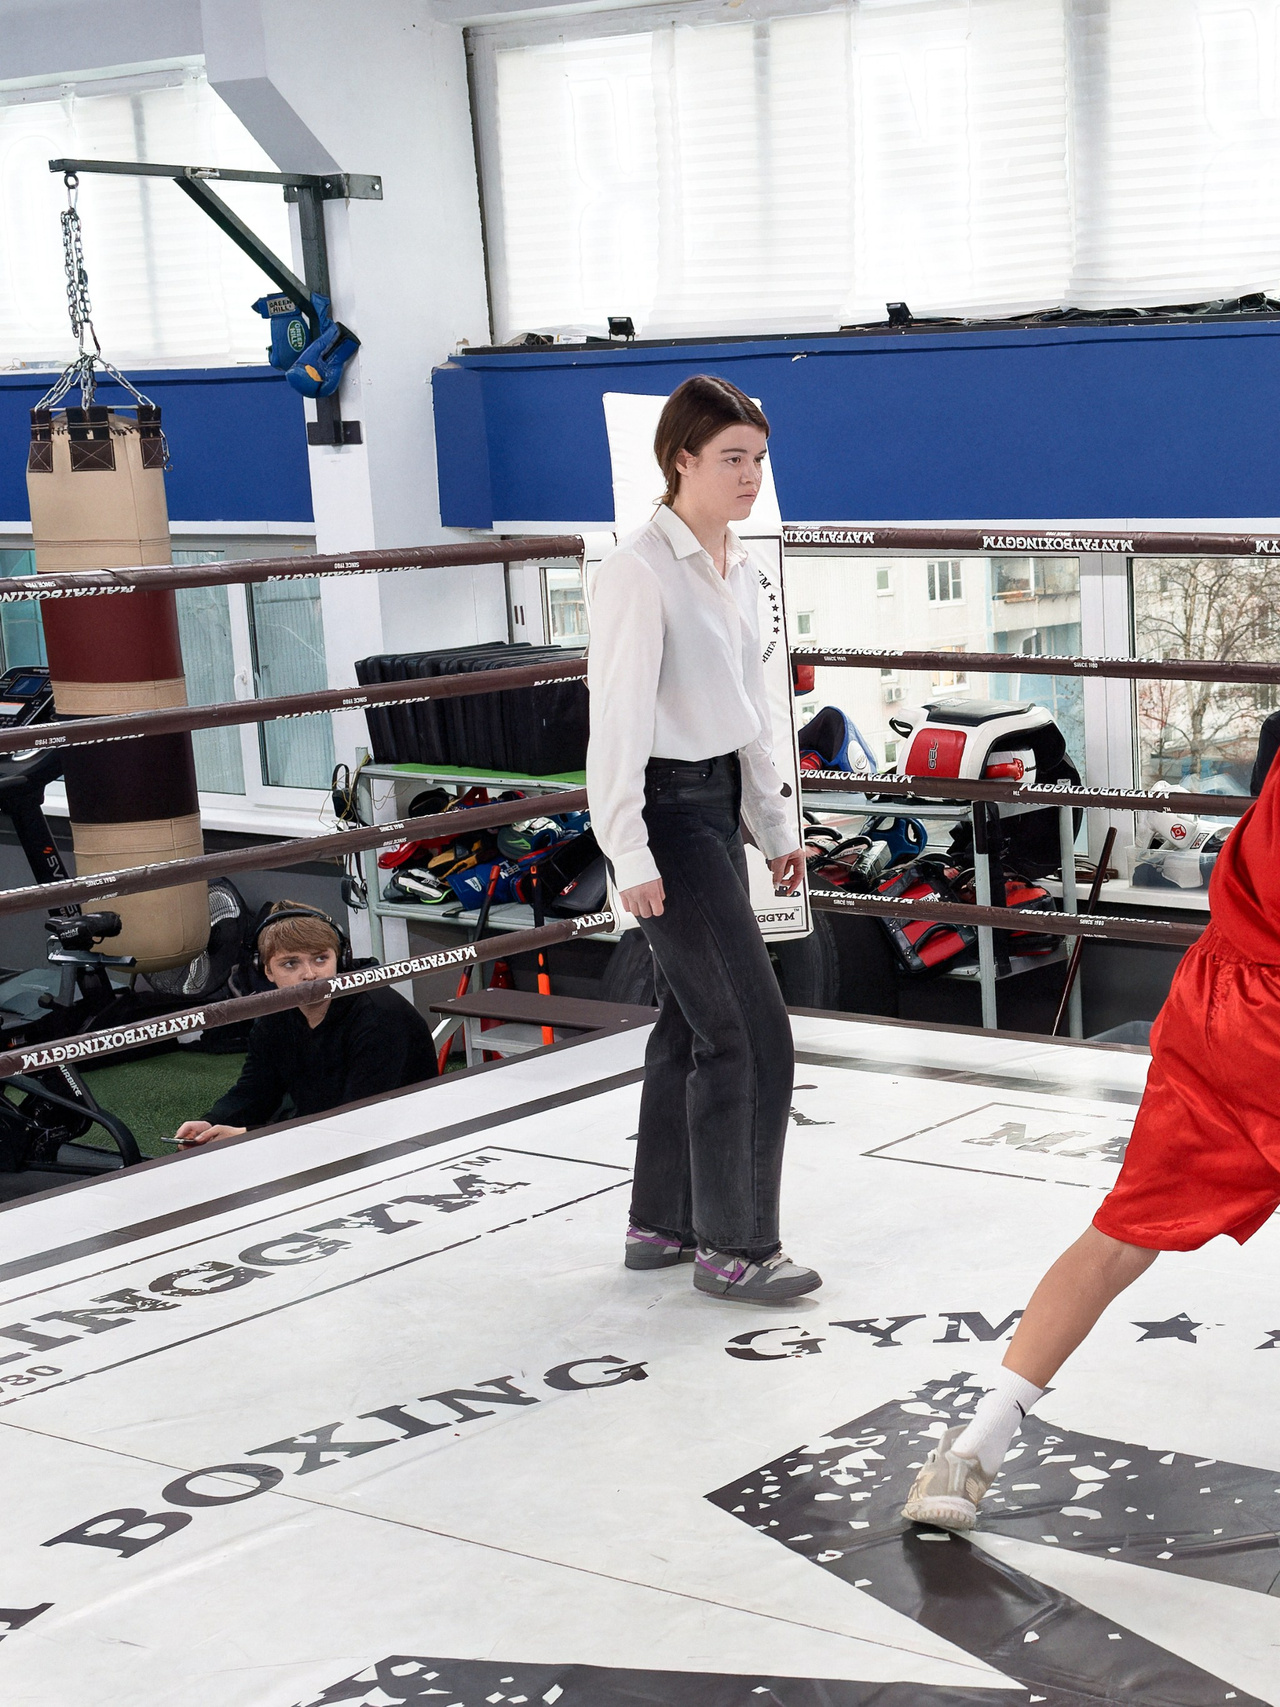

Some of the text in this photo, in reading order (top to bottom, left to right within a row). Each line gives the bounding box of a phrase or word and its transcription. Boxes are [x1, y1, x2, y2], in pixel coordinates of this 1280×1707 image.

[273, 305, 290, 313] HILL
[983, 536, 1134, 552] MAYFATBOXINGGYM
[328, 946, 478, 993] MAYFATBOXINGGYM
[21, 1012, 206, 1070] MAYFATBOXINGGYM
[58, 1064, 83, 1097] AIRBIKE
[0, 1153, 531, 1365] INGGYM TM
[0, 1365, 63, 1394] 80
[40, 1354, 649, 1559] BOXING
